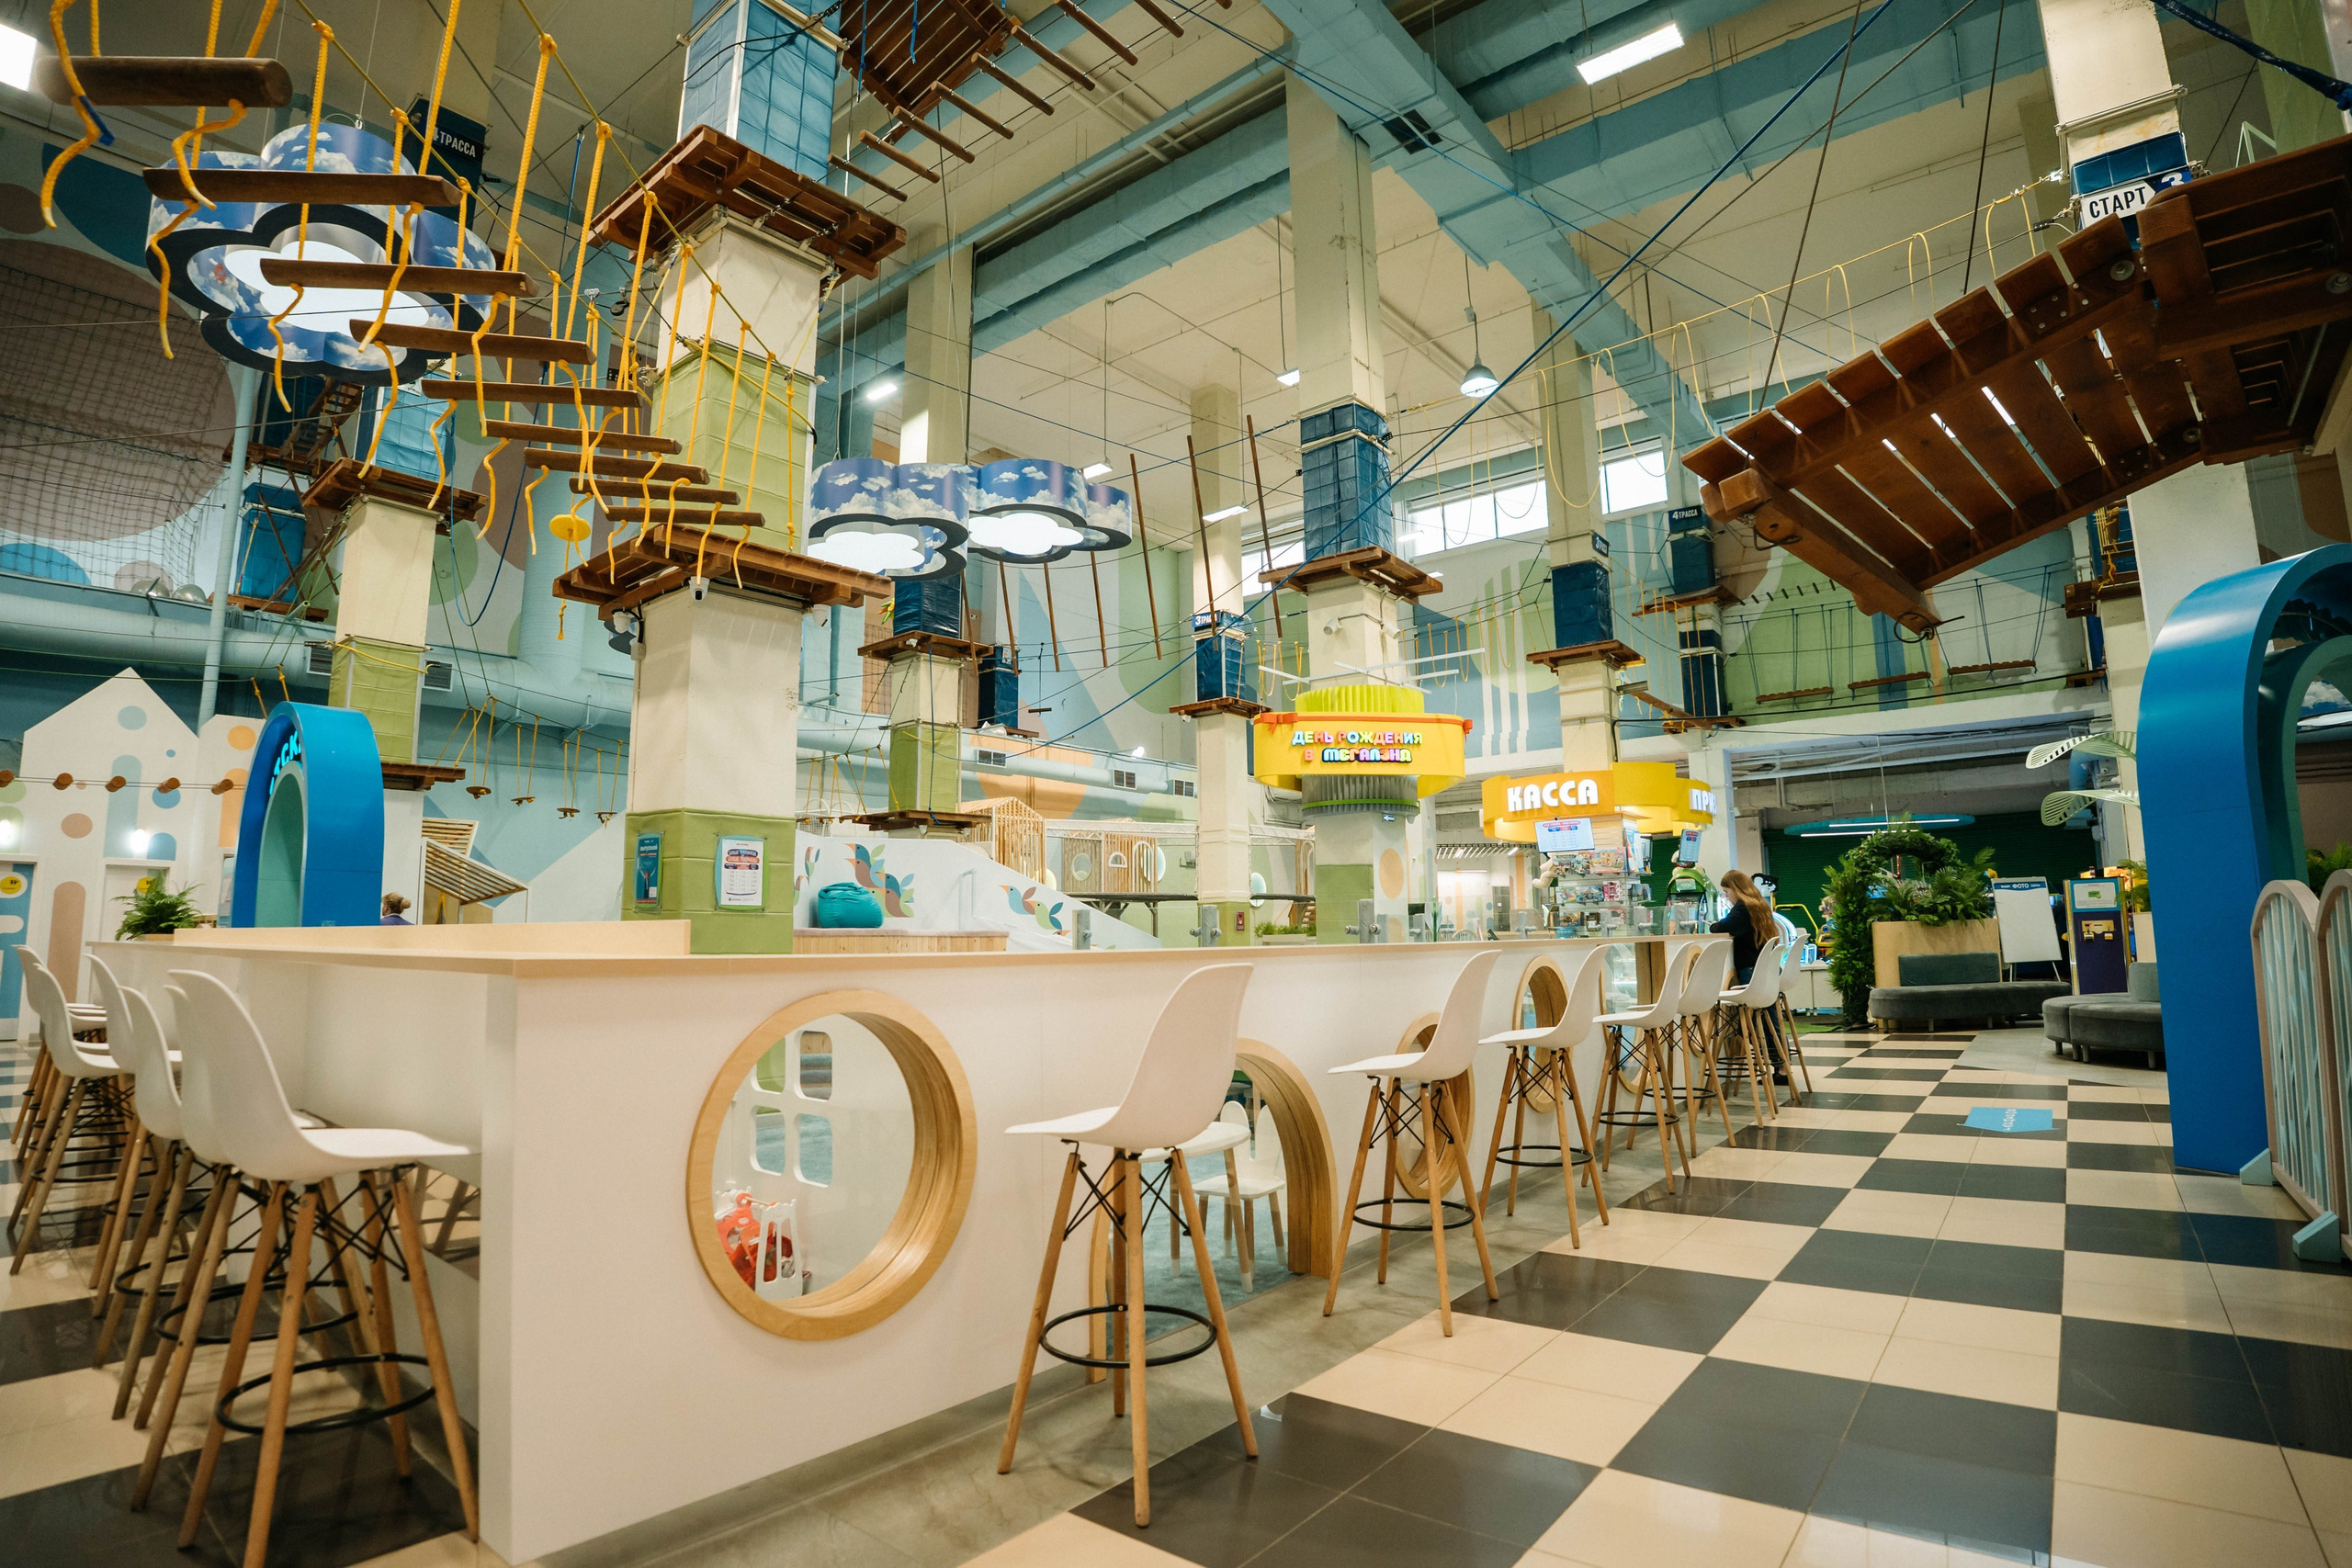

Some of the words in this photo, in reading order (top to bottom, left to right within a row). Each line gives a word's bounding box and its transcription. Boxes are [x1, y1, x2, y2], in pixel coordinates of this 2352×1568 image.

[440, 130, 476, 158] ТРАССА
[2089, 186, 2145, 219] СТАРТ
[1672, 512, 1679, 520] 4
[1679, 509, 1698, 519] ТРАССА
[1195, 615, 1202, 626] 3
[1292, 730, 1334, 746] ДЕНЬ
[1337, 730, 1423, 746] РОЖДЕНИЯ
[1304, 748, 1315, 761] В
[1322, 747, 1412, 762] МЕГАЛЭНД
[1508, 779, 1599, 813] КАССА
